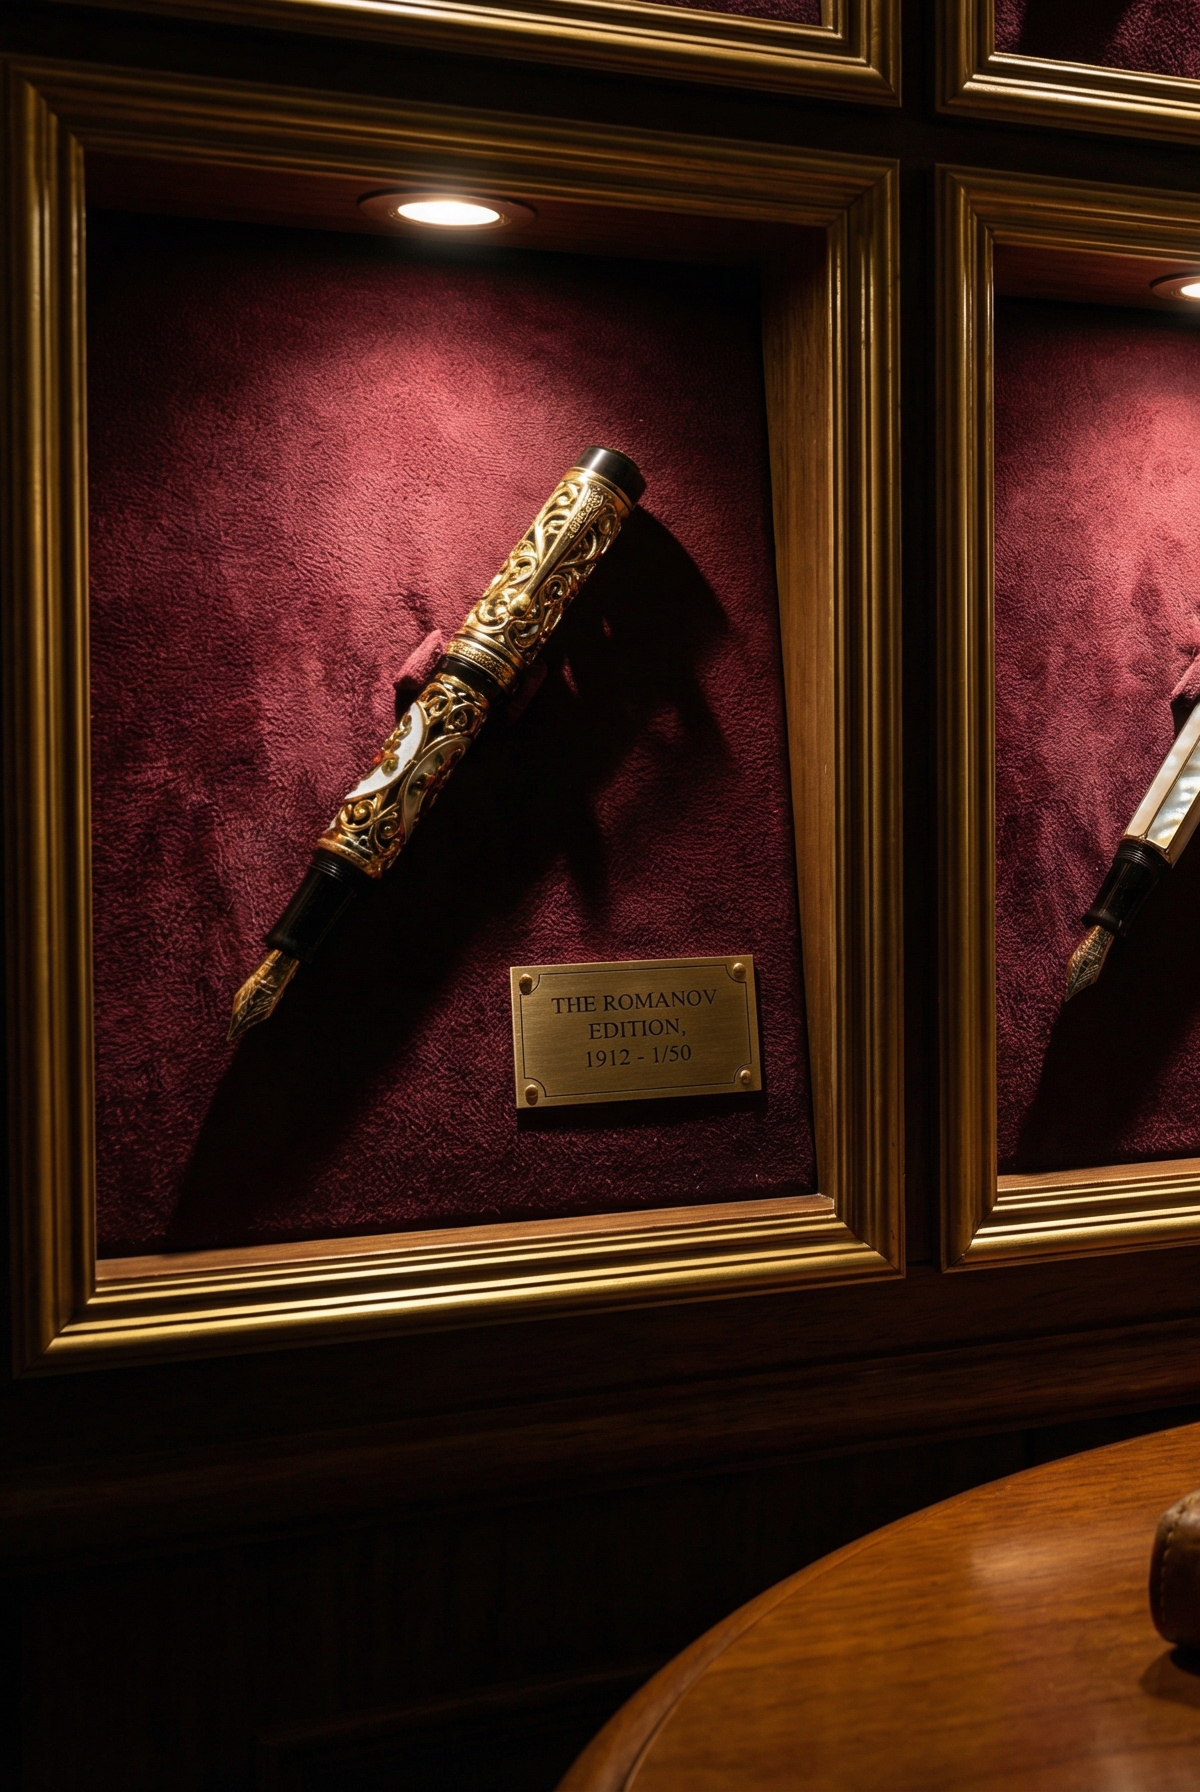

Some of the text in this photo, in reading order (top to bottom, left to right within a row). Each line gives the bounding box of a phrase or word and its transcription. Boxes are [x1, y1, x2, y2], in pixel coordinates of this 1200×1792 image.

[551, 989, 717, 1014] THE ROMANOV
[588, 1018, 686, 1040] EDITION,
[586, 1049, 631, 1068] 1912
[652, 1044, 692, 1063] 1/50
